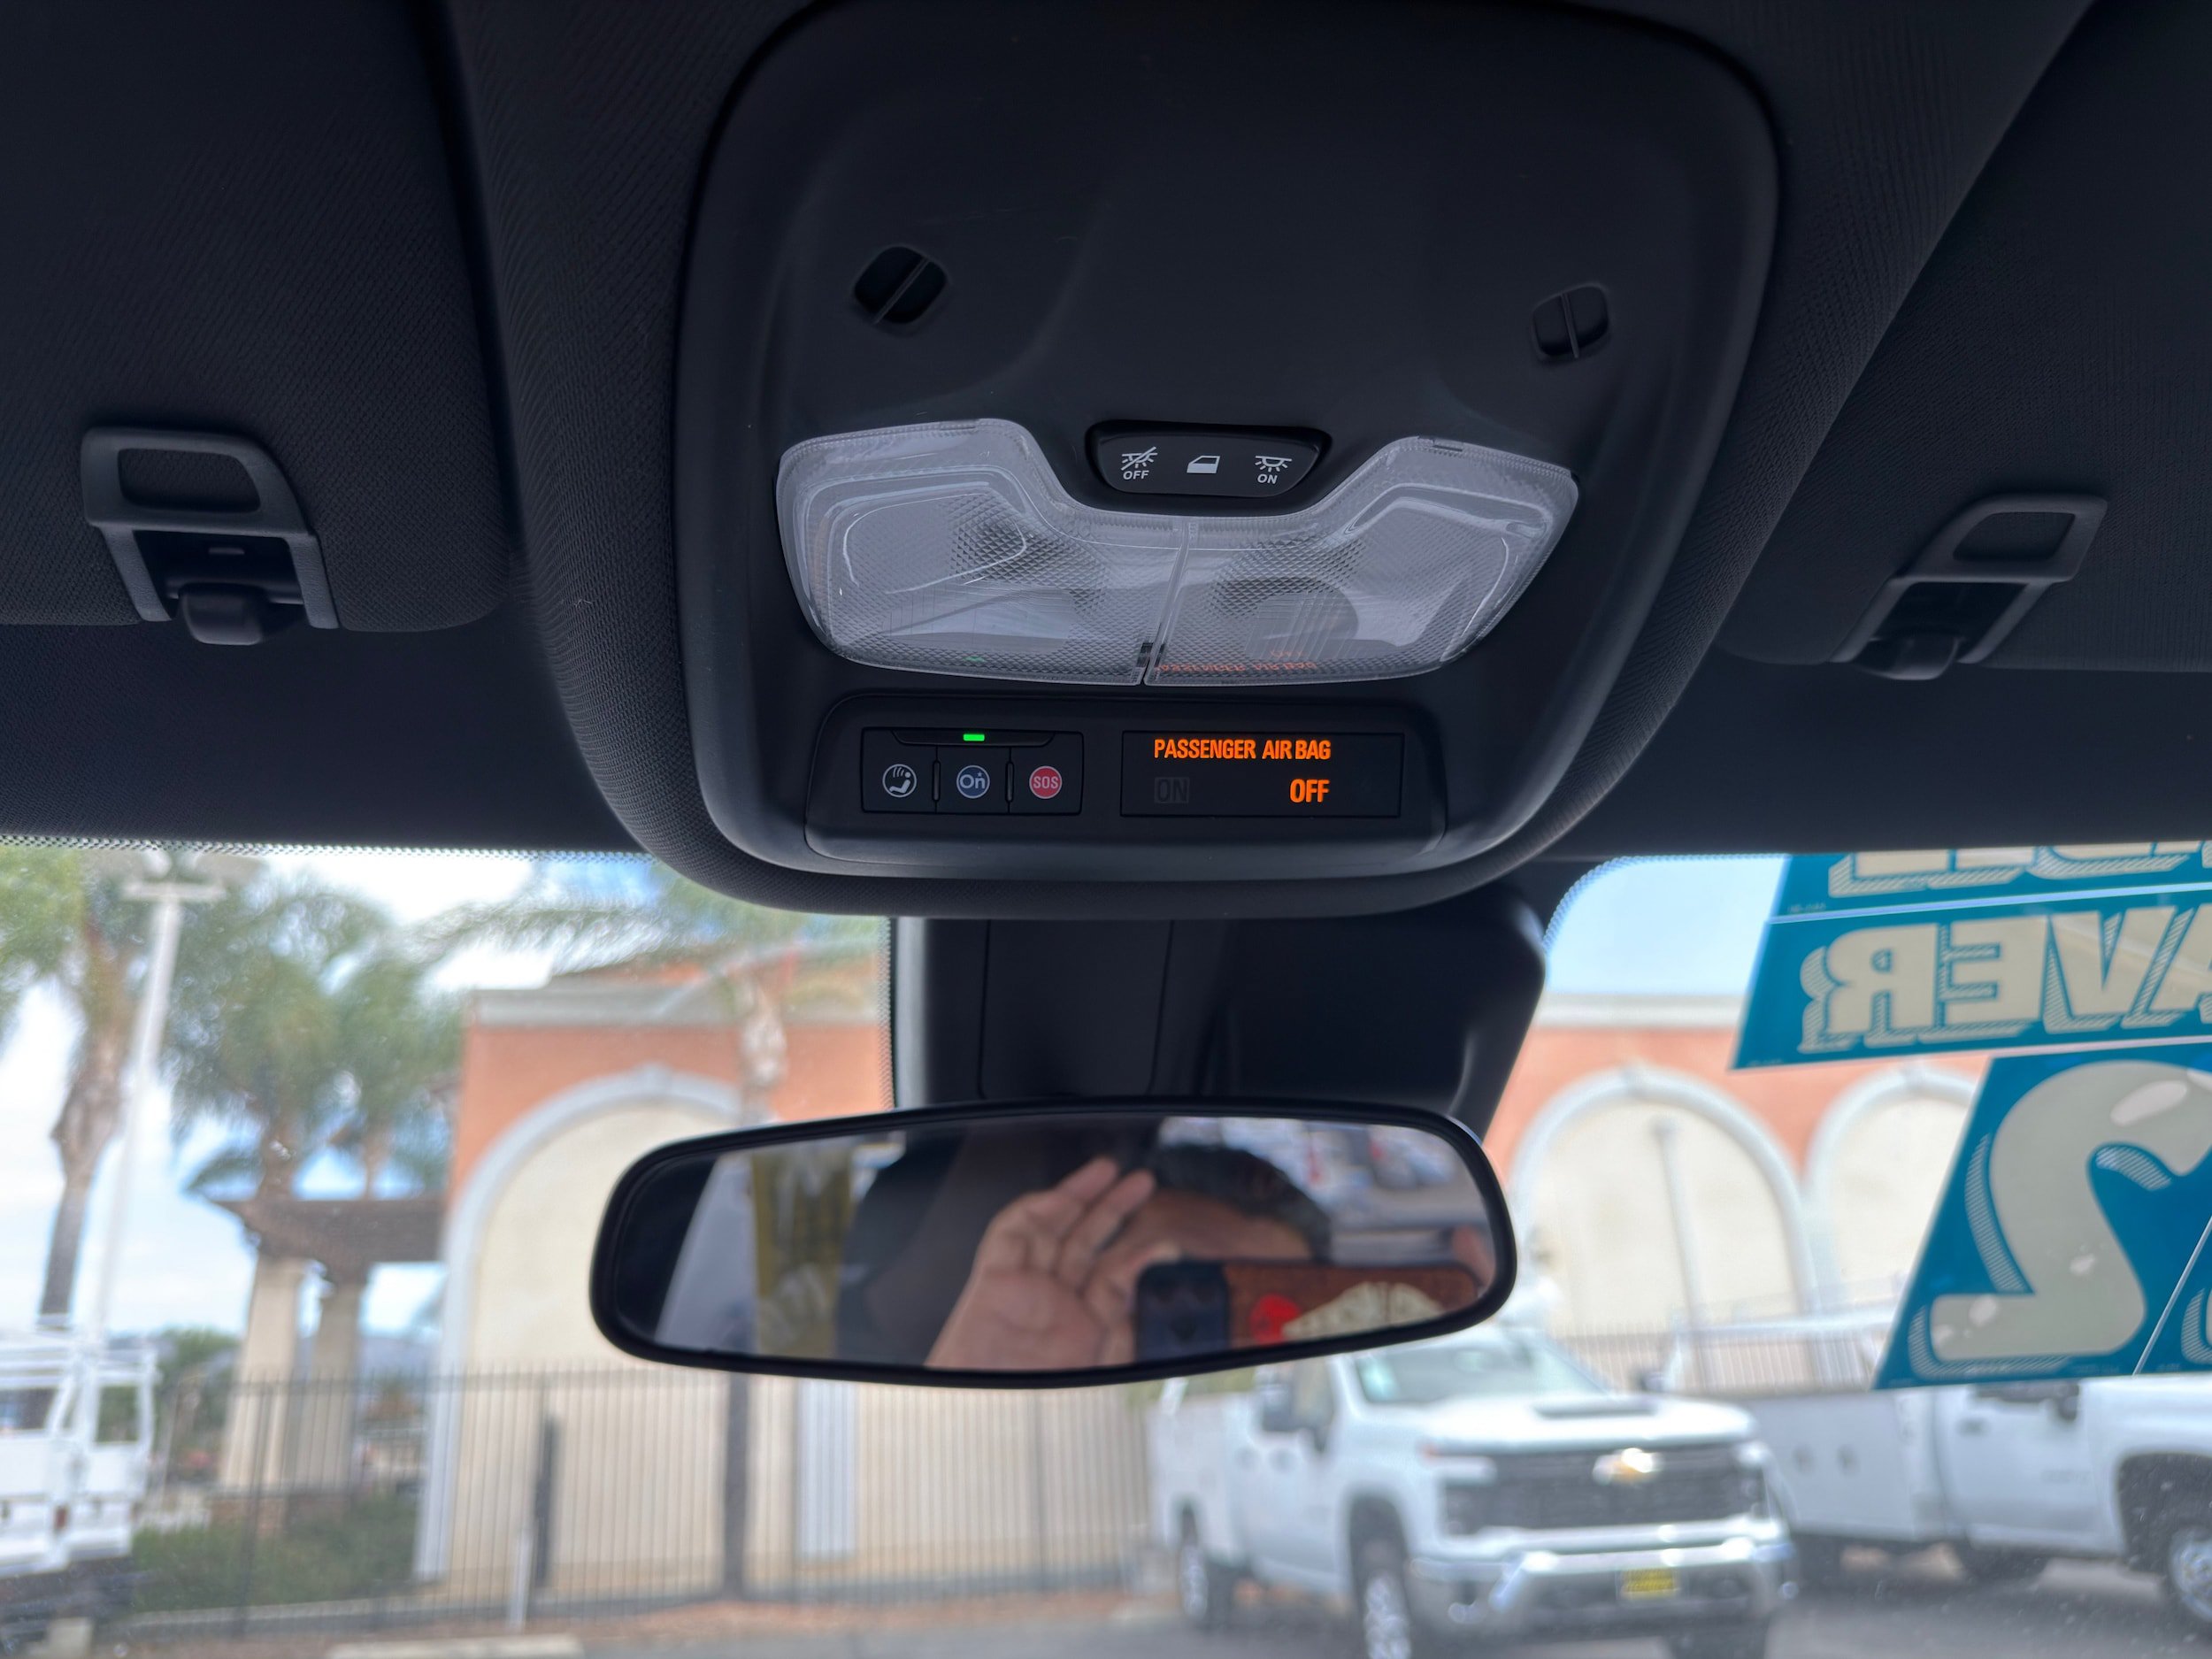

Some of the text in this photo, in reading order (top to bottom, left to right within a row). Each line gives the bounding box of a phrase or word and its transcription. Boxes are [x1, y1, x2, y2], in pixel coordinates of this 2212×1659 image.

[1122, 470, 1150, 480] OFF
[1256, 473, 1278, 484] ON
[1154, 738, 1331, 760] PASSENGER AIR BAG
[959, 772, 986, 789] On
[1033, 776, 1059, 789] SOS
[1157, 778, 1188, 803] ON
[1290, 779, 1330, 803] OFF
